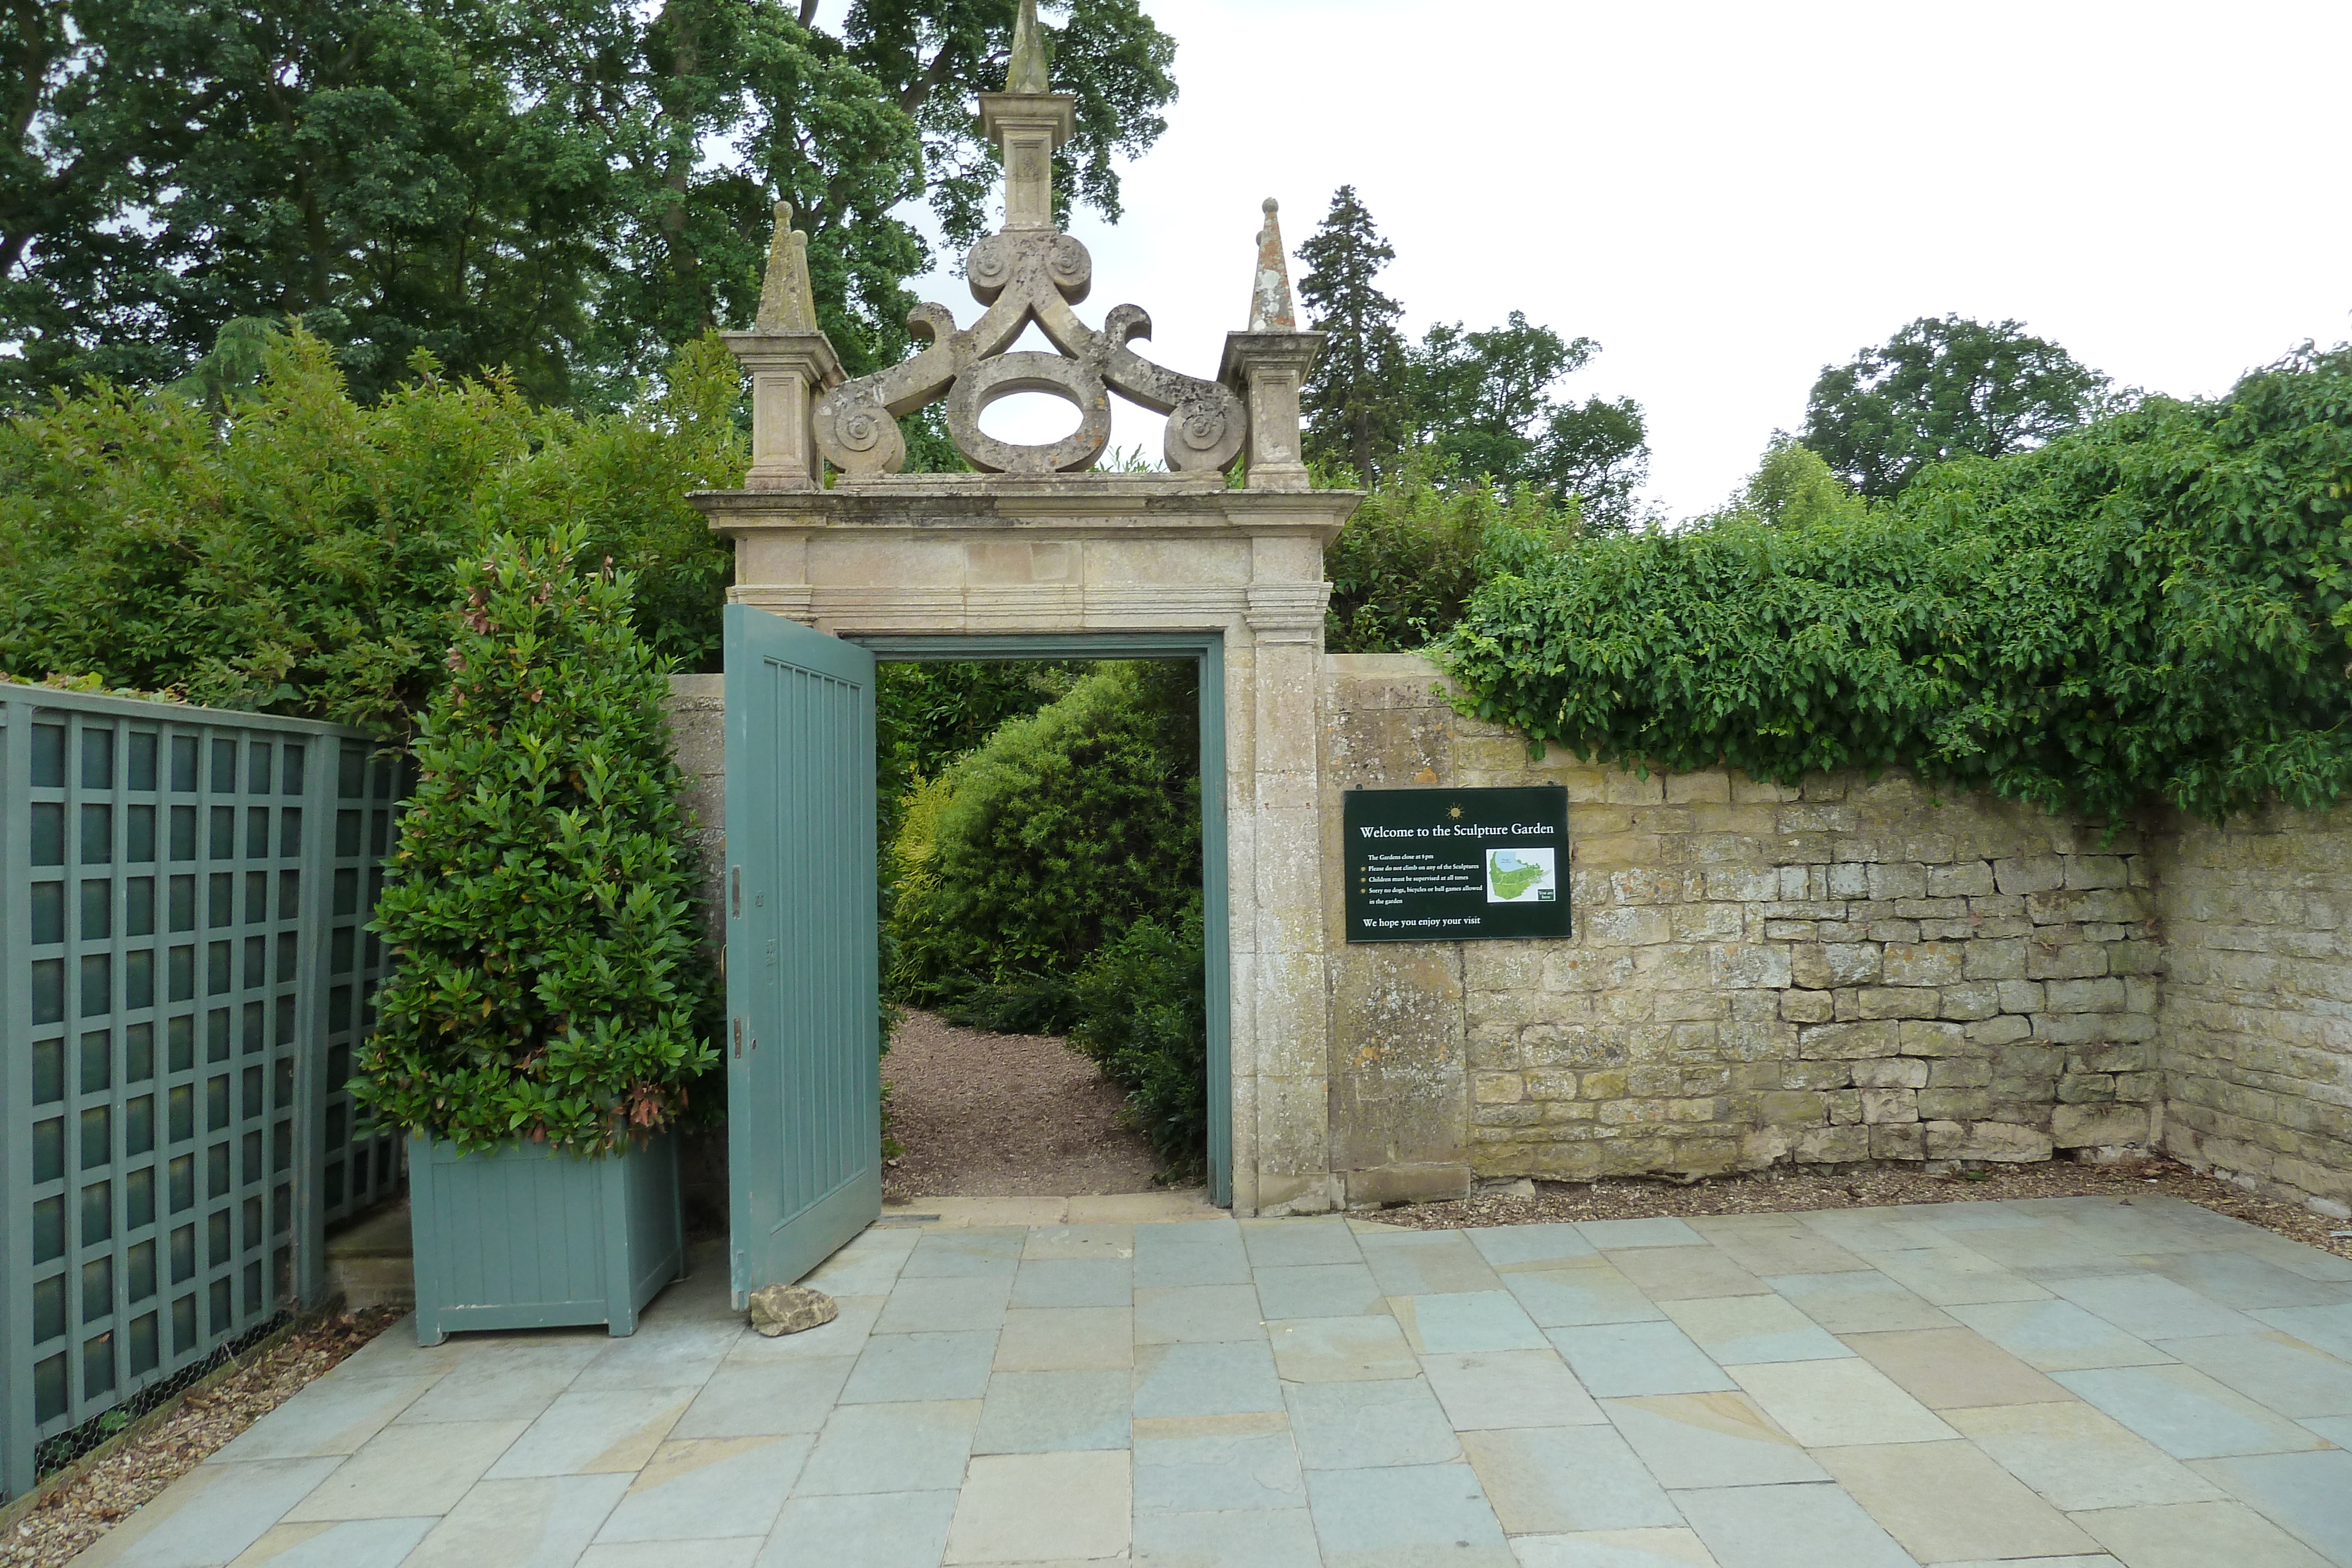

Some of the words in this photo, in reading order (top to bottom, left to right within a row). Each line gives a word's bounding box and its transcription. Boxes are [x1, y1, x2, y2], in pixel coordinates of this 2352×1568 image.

[1359, 825, 1414, 838] Welcome
[1416, 828, 1429, 837] to
[1432, 824, 1451, 836] the
[1454, 824, 1508, 838] Sculpture
[1511, 823, 1554, 834] Garden
[1363, 919, 1377, 927] We
[1379, 918, 1399, 928] hope
[1401, 920, 1416, 928] you
[1418, 917, 1440, 927] enjoy
[1442, 918, 1462, 927] your
[1464, 916, 1481, 924] visit
